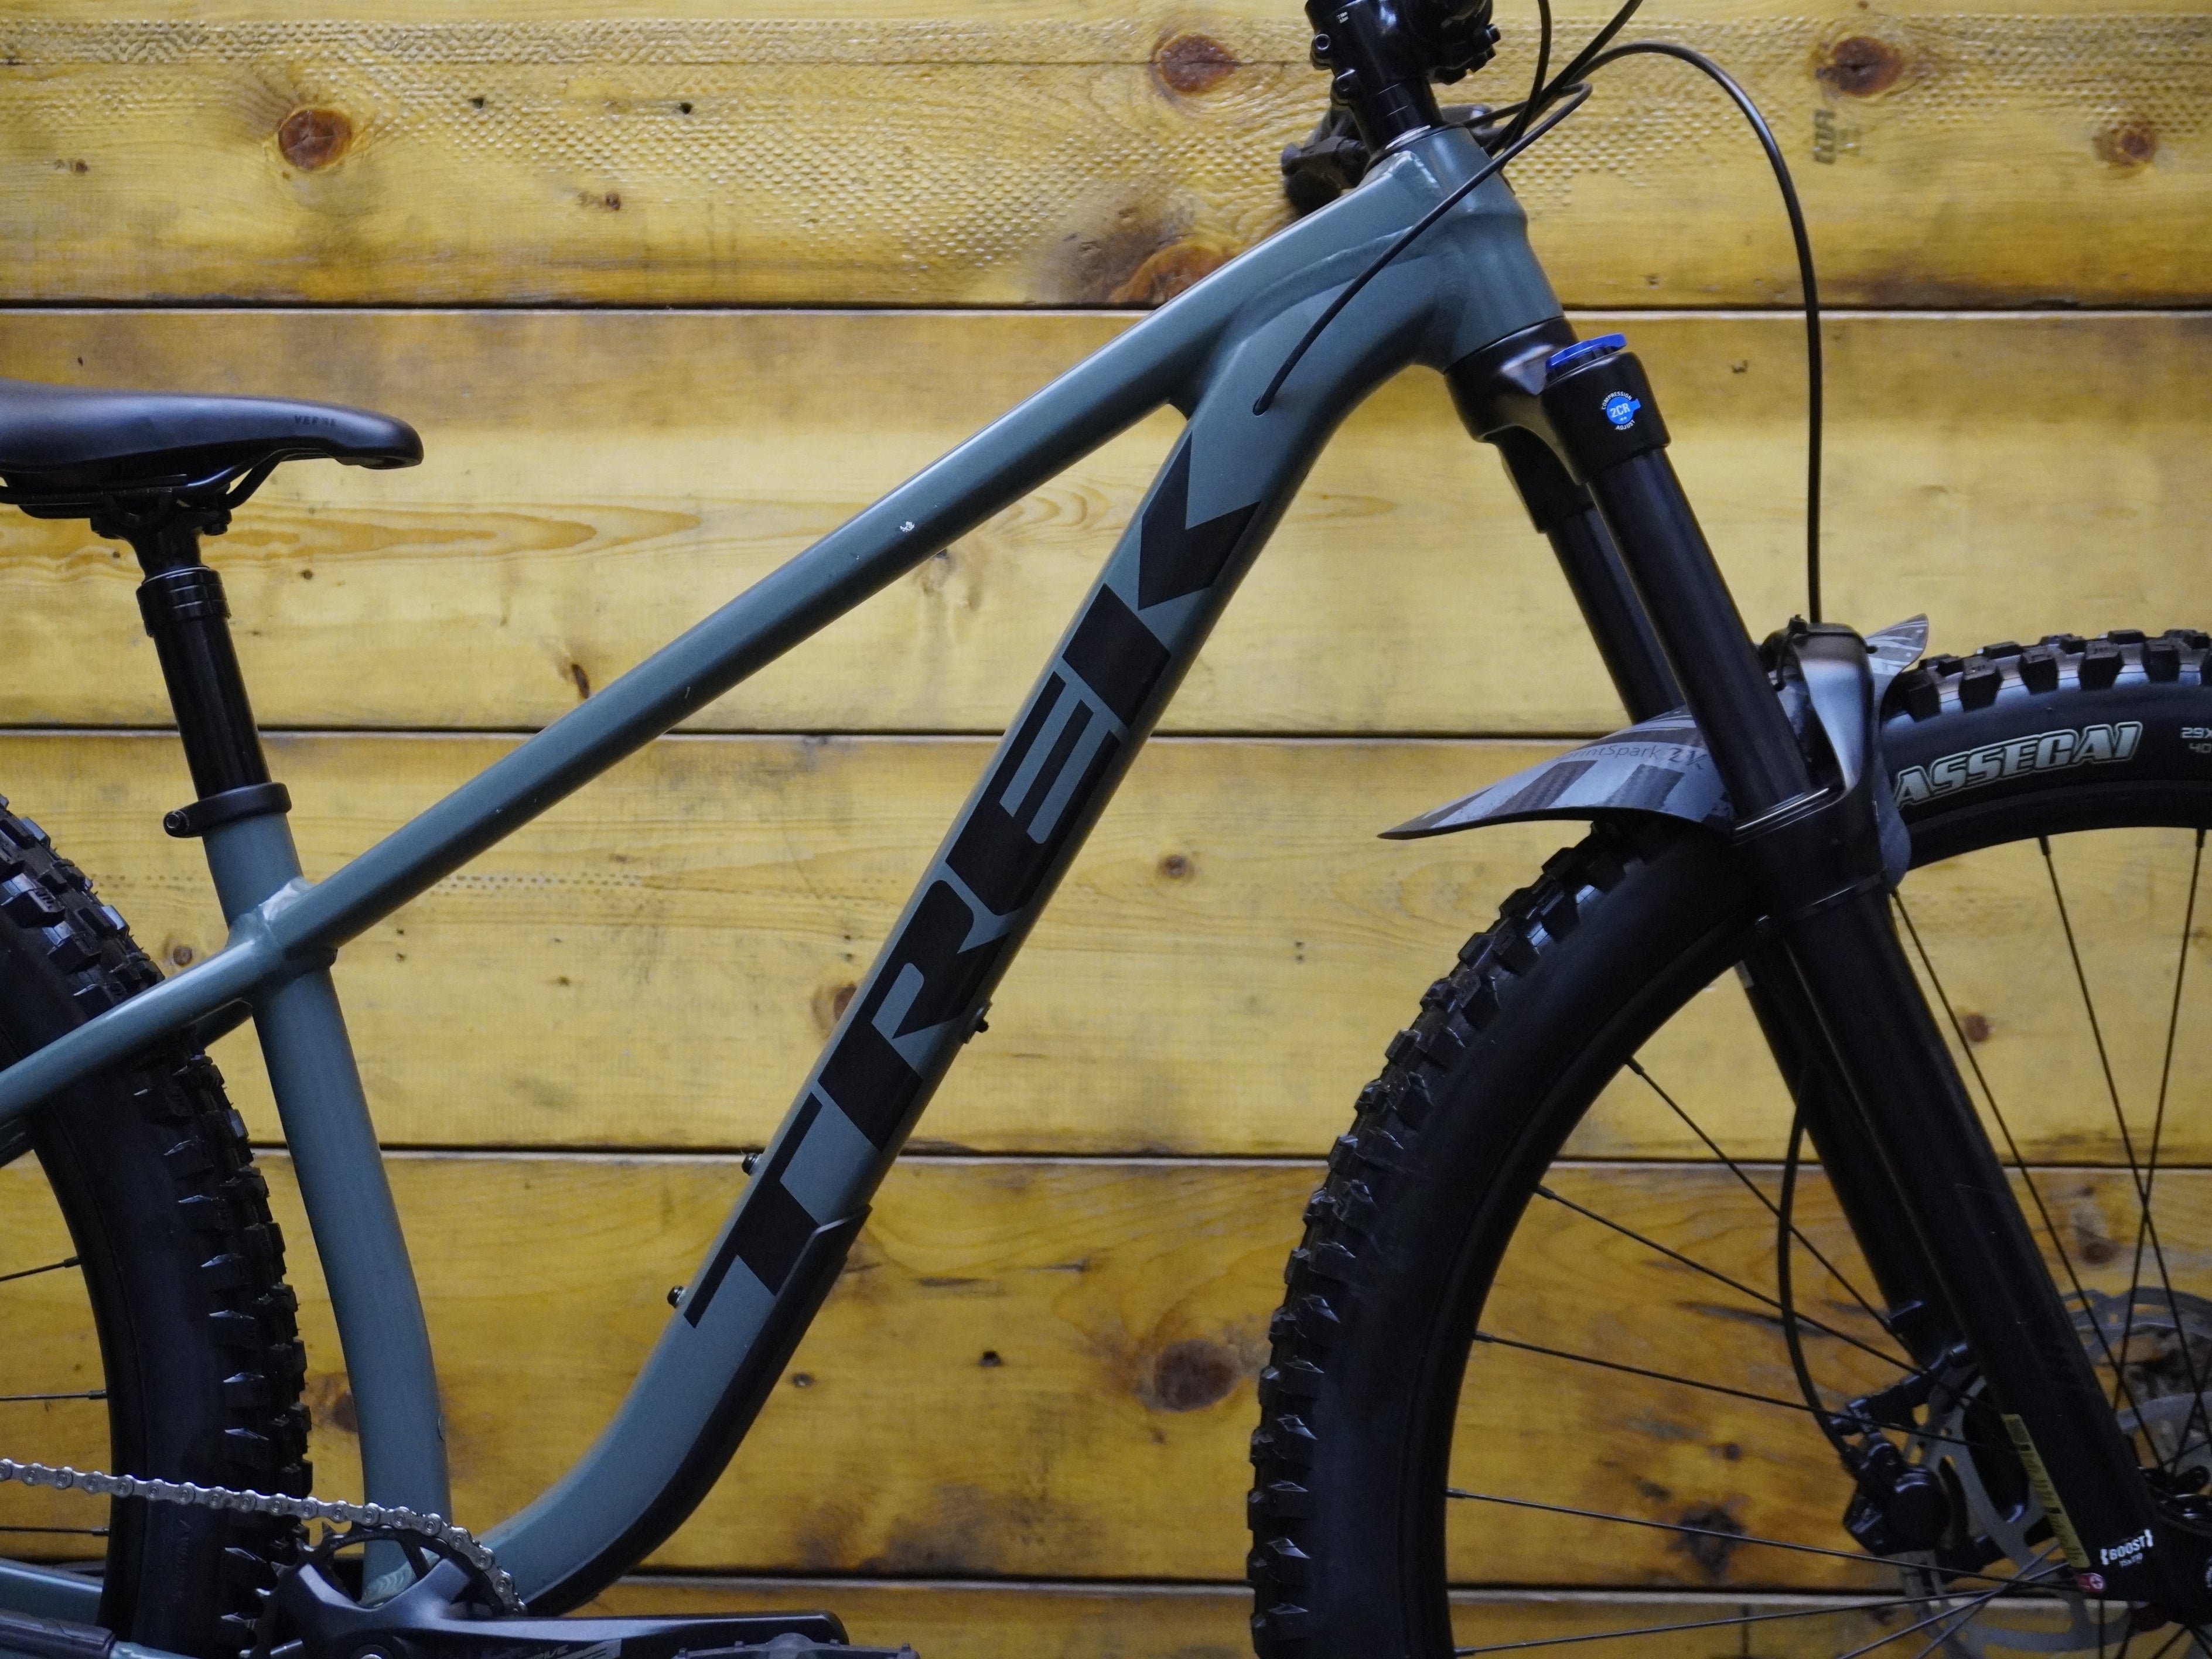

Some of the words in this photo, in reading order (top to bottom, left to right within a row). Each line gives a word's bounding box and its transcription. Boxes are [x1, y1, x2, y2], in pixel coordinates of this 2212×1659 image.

[1601, 391, 1632, 409] COMPRESSION
[1610, 402, 1631, 418] 2CR
[1616, 419, 1636, 430] ADJUST
[1894, 721, 2143, 808] ASSEGAI
[684, 431, 1261, 1329] TREK
